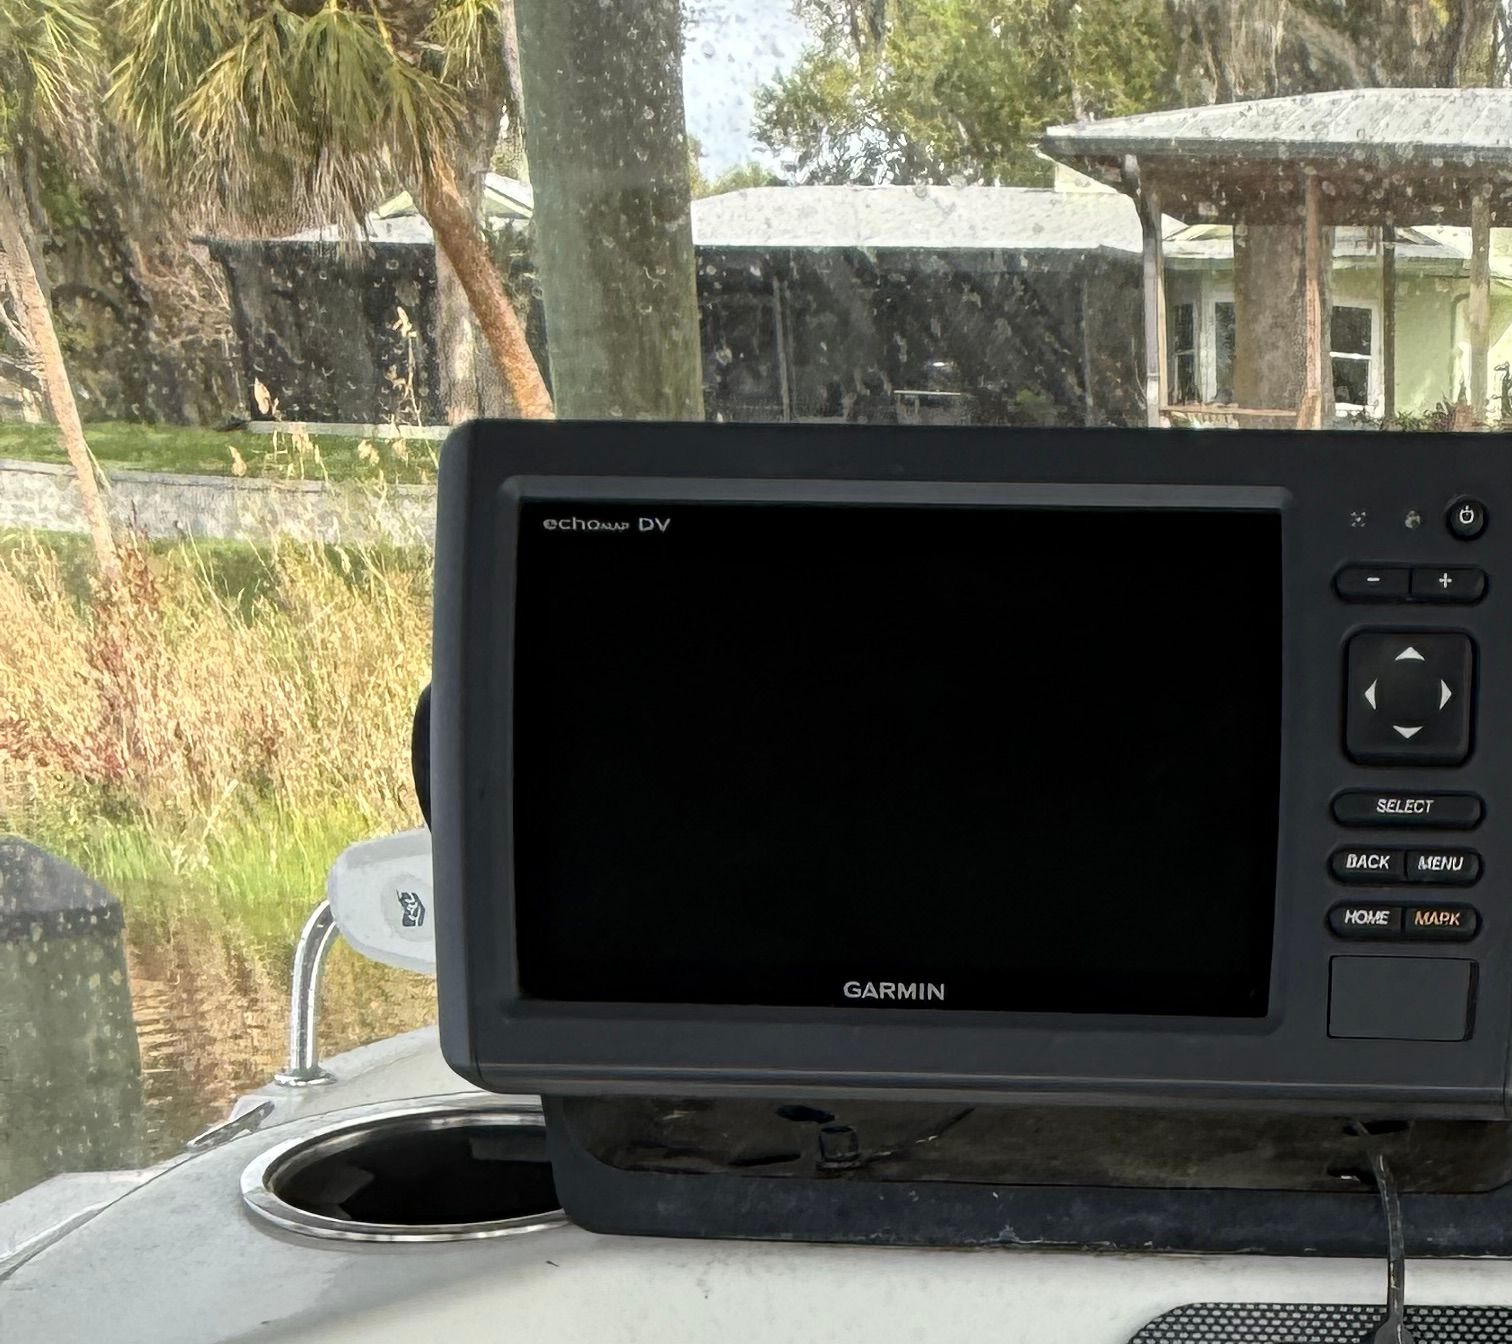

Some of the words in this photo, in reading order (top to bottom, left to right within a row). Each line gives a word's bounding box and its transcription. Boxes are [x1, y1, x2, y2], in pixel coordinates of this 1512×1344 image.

[638, 517, 672, 532] DV
[1376, 798, 1434, 814] SELECT
[1345, 853, 1391, 870] BACK
[1417, 855, 1464, 872] MENU
[1344, 909, 1391, 925] HOME
[1414, 911, 1461, 926] MARK
[843, 981, 945, 1001] GARMIN
